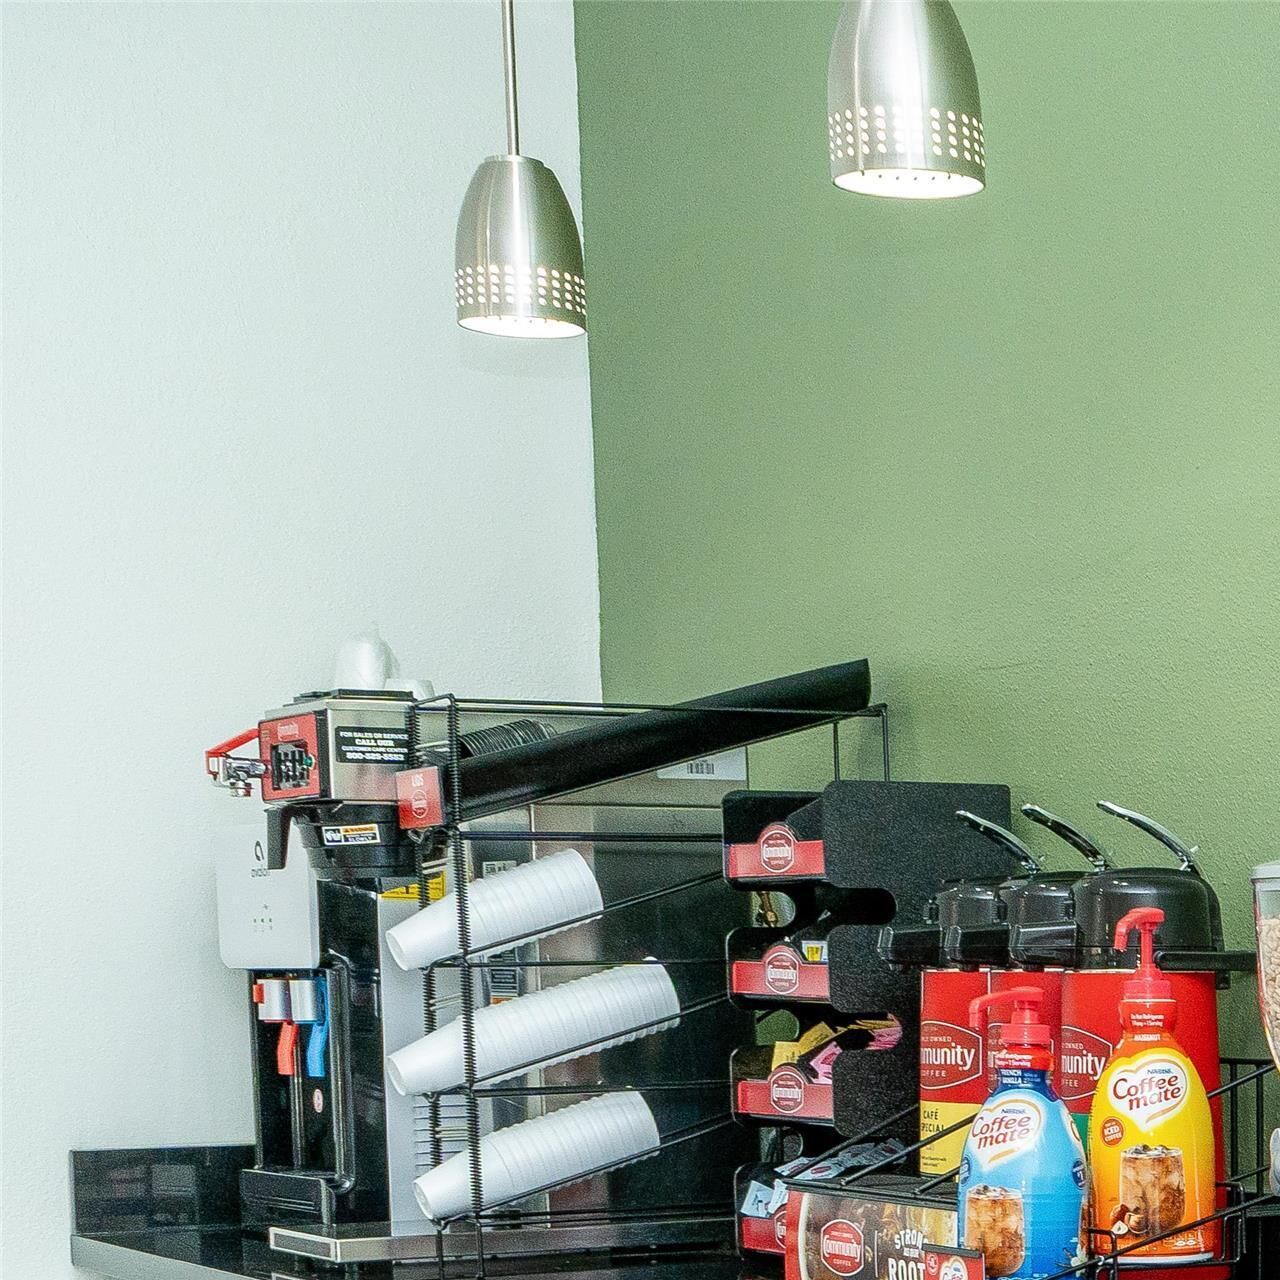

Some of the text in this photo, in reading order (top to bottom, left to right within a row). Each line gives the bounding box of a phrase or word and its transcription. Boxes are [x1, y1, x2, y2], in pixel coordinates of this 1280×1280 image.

[1113, 1075, 1178, 1099] Coffee
[1129, 1087, 1181, 1111] mate
[972, 1116, 1031, 1138] Coffee
[978, 1128, 1030, 1149] mate
